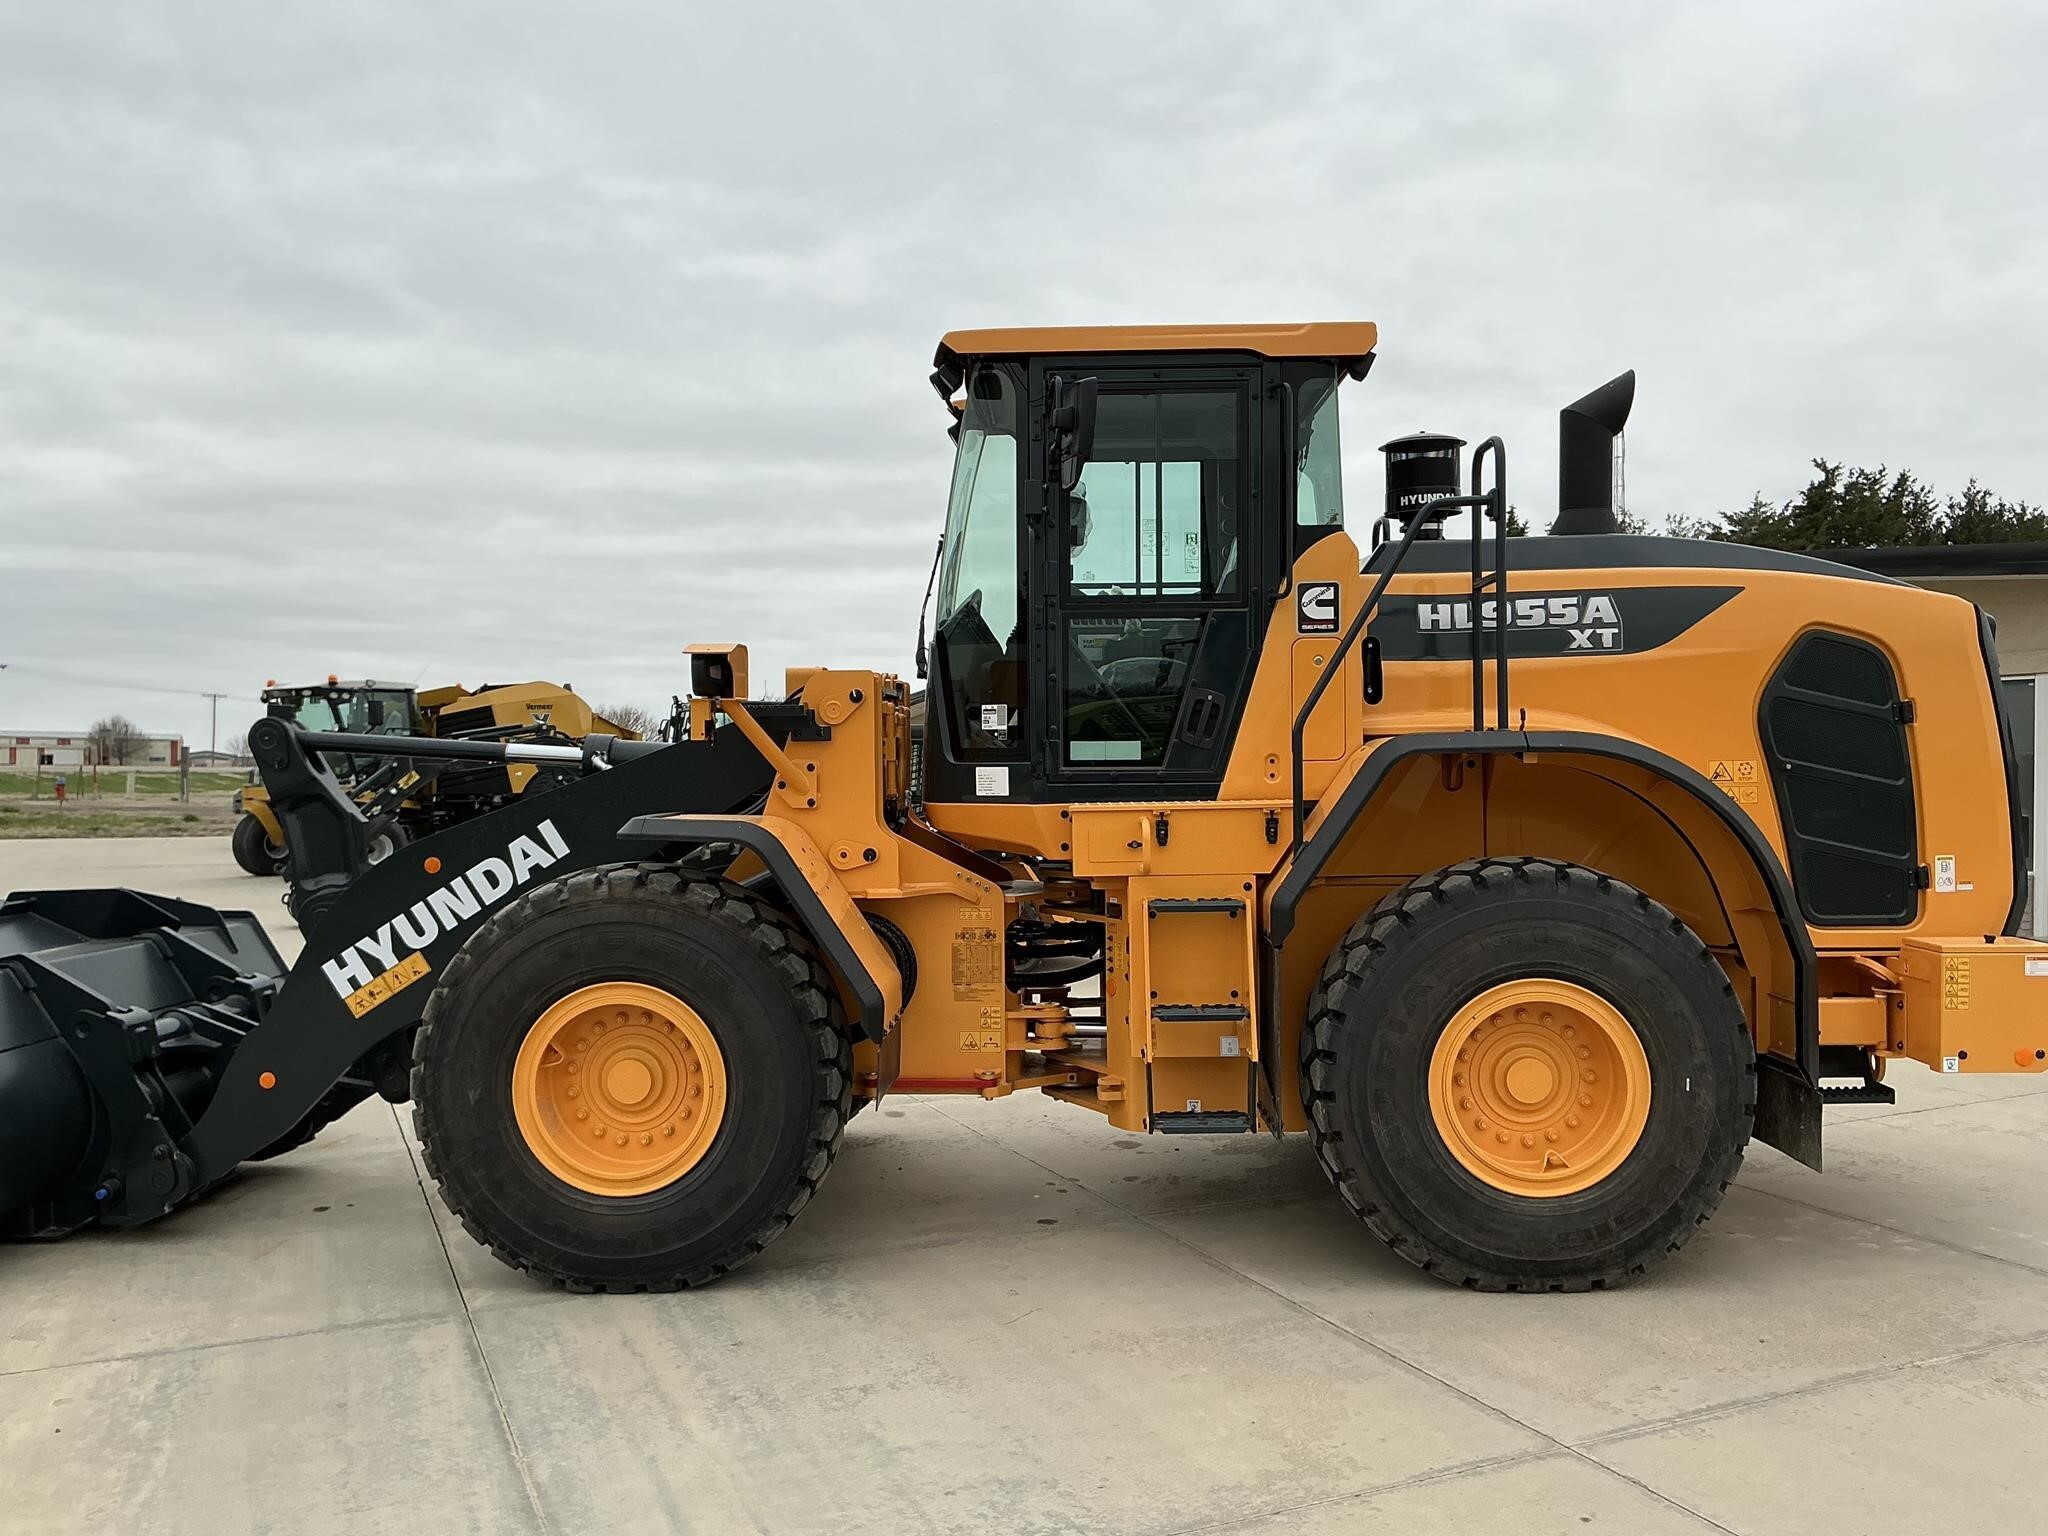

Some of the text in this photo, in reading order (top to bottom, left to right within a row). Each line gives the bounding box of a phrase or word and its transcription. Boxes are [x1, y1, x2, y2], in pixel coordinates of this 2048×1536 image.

[1302, 587, 1332, 608] Cummins
[1417, 596, 1618, 630] HL955A
[1566, 628, 1619, 649] XT
[320, 818, 571, 1000] HYUNDAI
